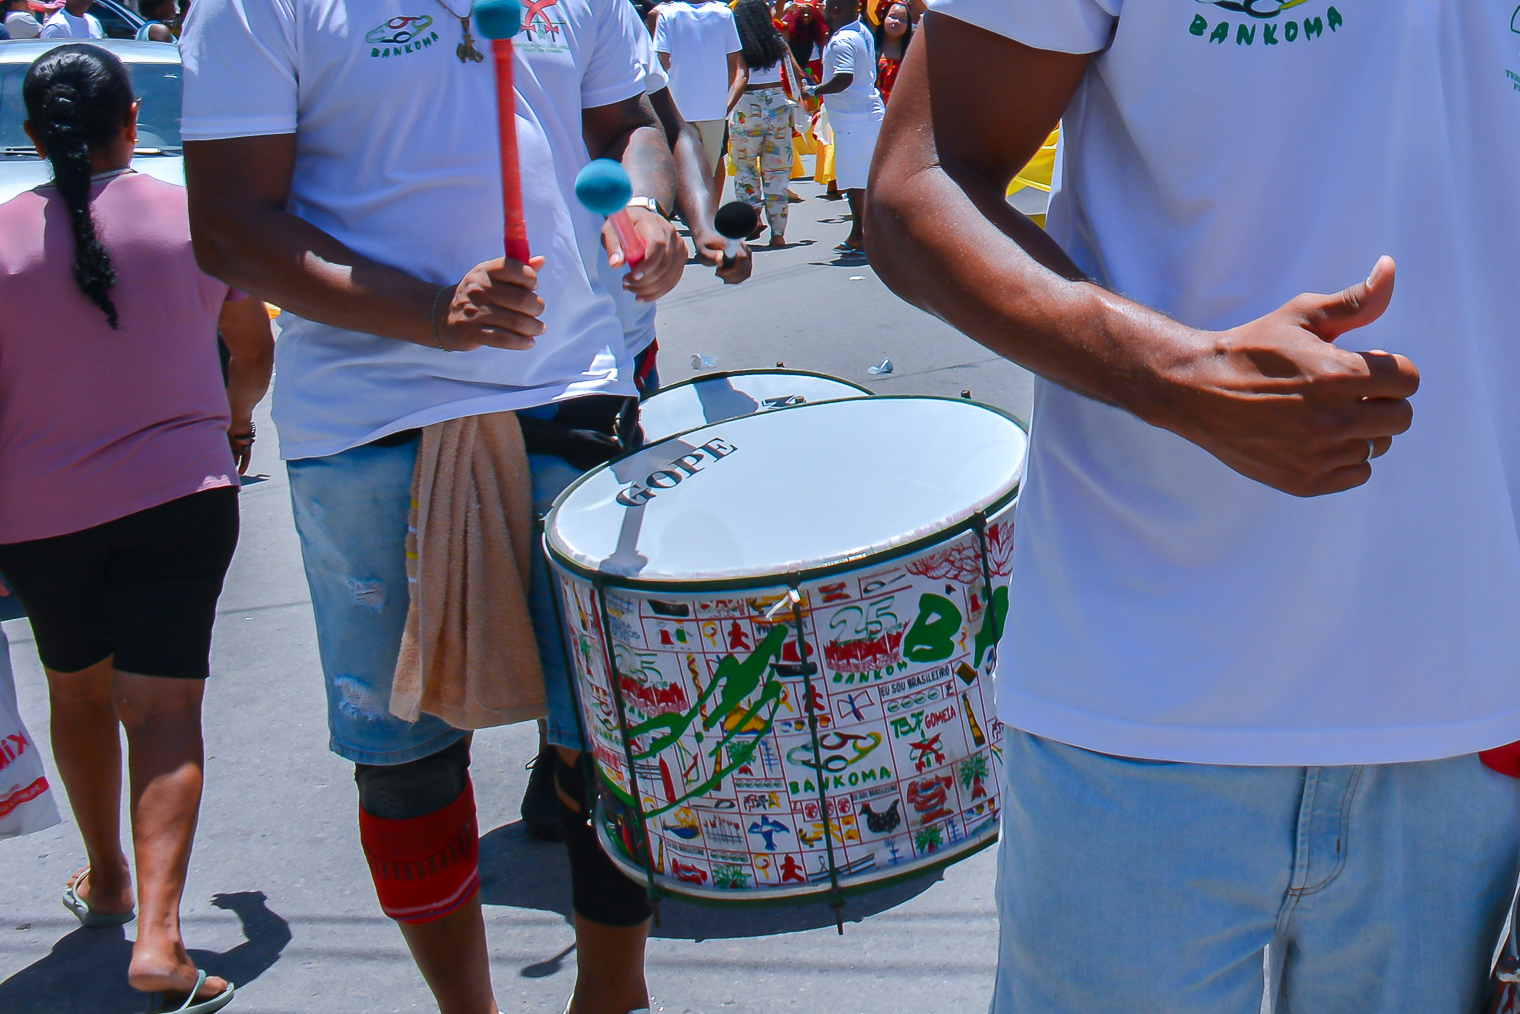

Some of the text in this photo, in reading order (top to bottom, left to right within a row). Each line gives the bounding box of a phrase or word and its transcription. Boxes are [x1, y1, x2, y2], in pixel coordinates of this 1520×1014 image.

[1189, 6, 1343, 46] BANKOMA
[371, 31, 440, 58] BANKOMA
[616, 437, 738, 508] GOPE
[881, 684, 890, 697] EU
[892, 679, 906, 693] SOU
[924, 705, 957, 730] GOMEIA
[789, 765, 892, 795] BANKOMA
